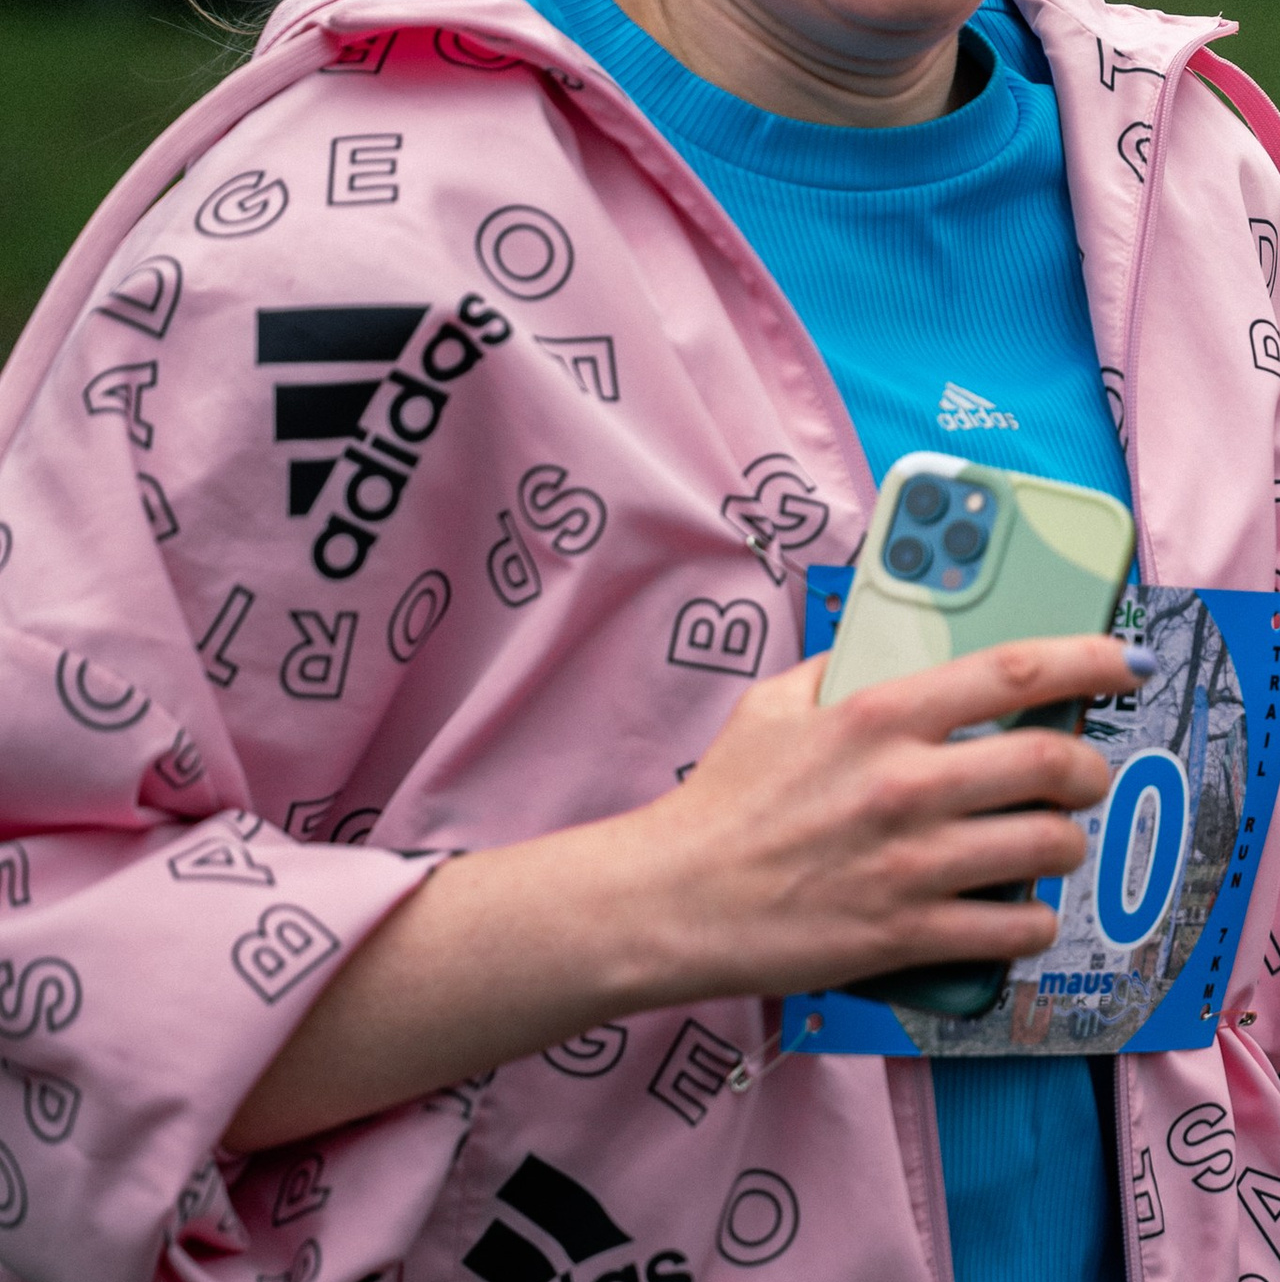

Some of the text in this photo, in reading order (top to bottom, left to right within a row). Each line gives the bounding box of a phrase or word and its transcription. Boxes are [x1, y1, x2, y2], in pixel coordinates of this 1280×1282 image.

[312, 291, 513, 580] adidas
[936, 406, 1020, 432] adidas
[1230, 817, 1256, 889] RUN
[1039, 972, 1115, 995] maus
